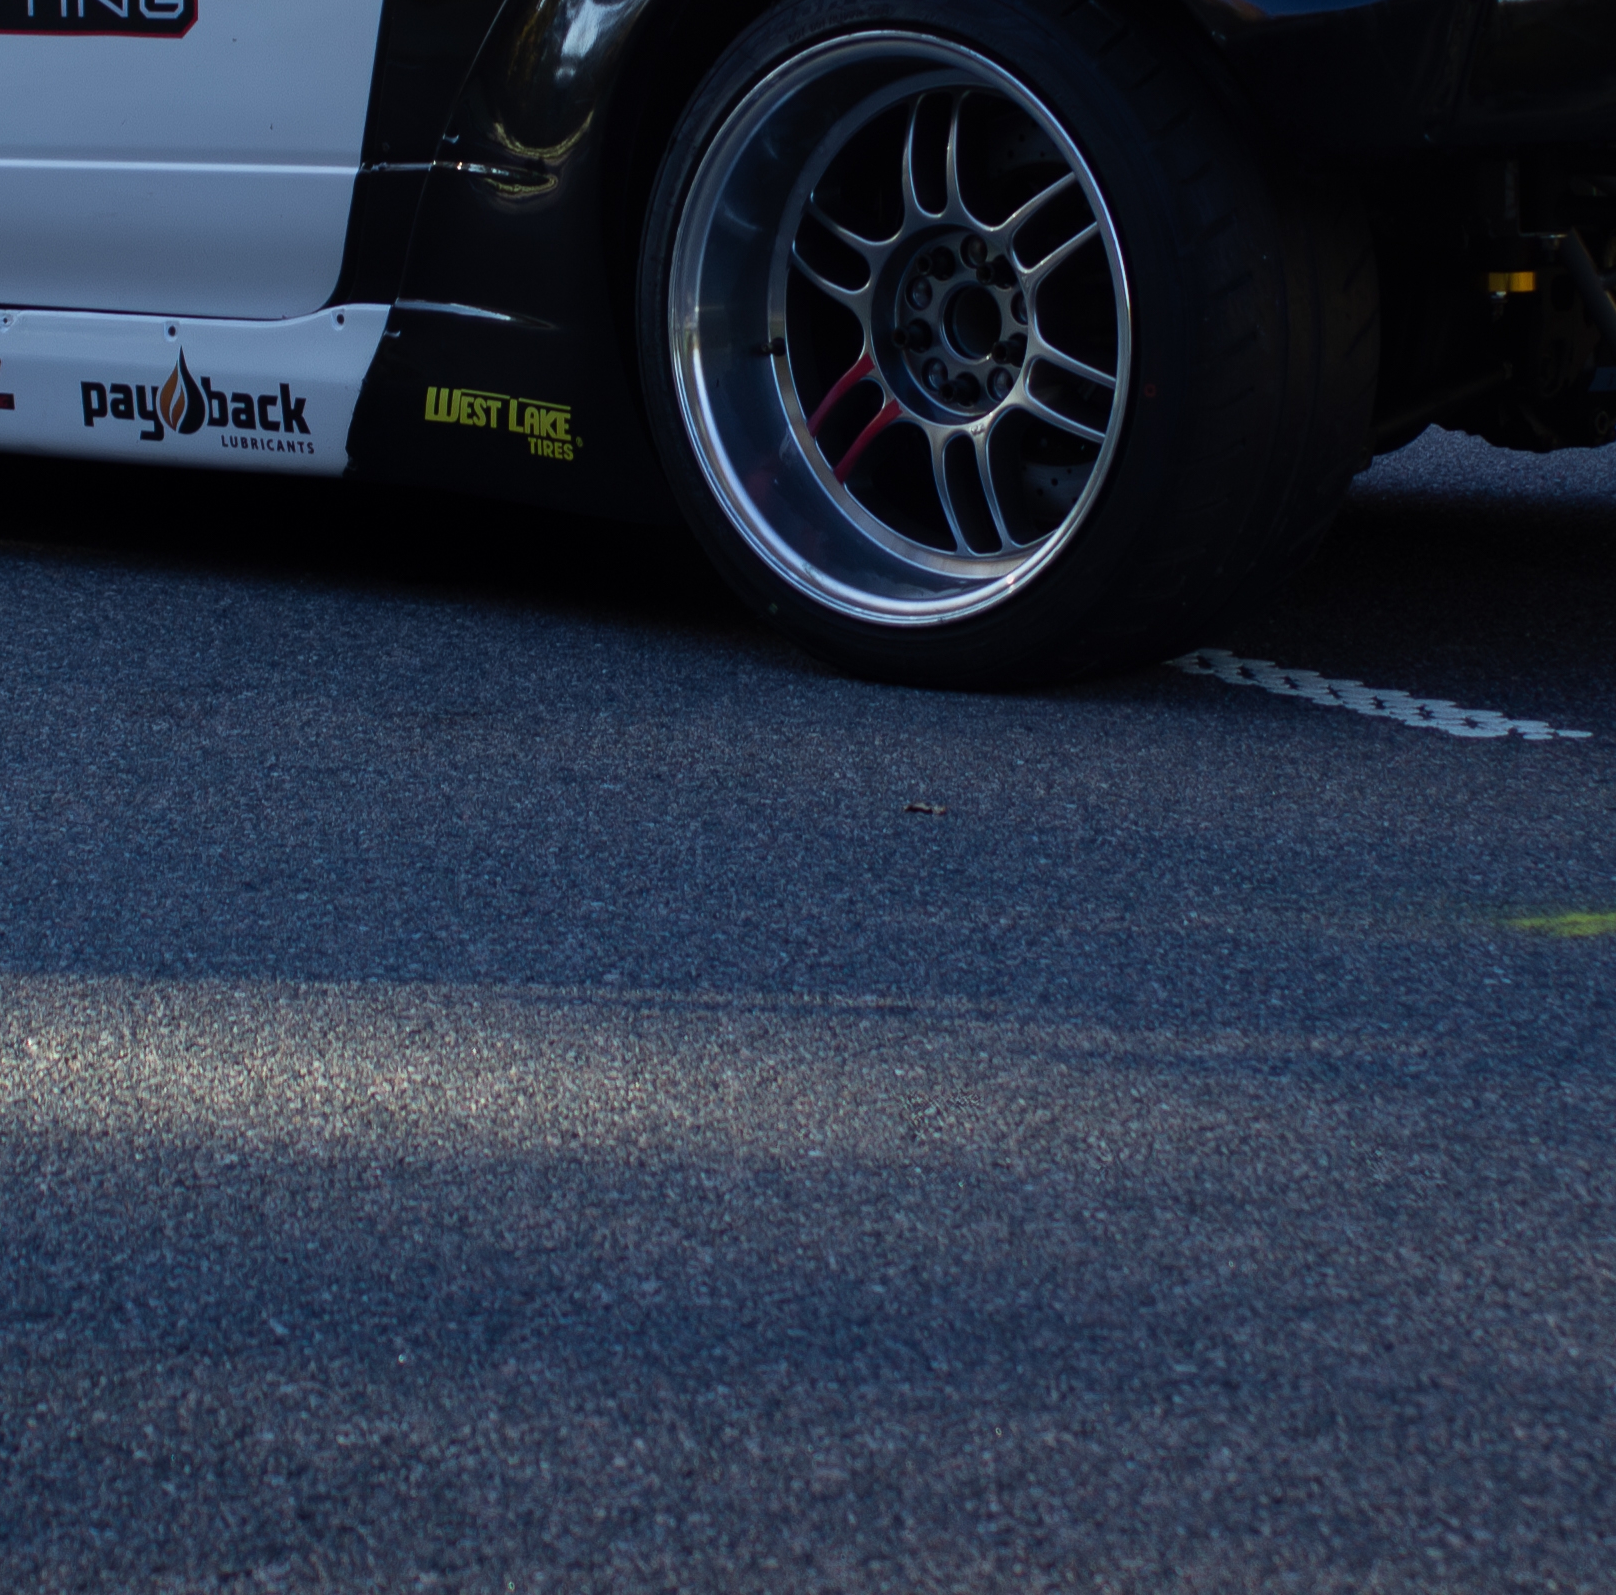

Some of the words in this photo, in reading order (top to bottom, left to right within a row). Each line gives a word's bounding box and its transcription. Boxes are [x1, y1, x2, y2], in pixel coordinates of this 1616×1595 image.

[424, 386, 507, 428] WEST
[508, 397, 572, 441] LAKE
[220, 434, 315, 455] LUBRICANTS
[528, 436, 575, 461] TIRES
